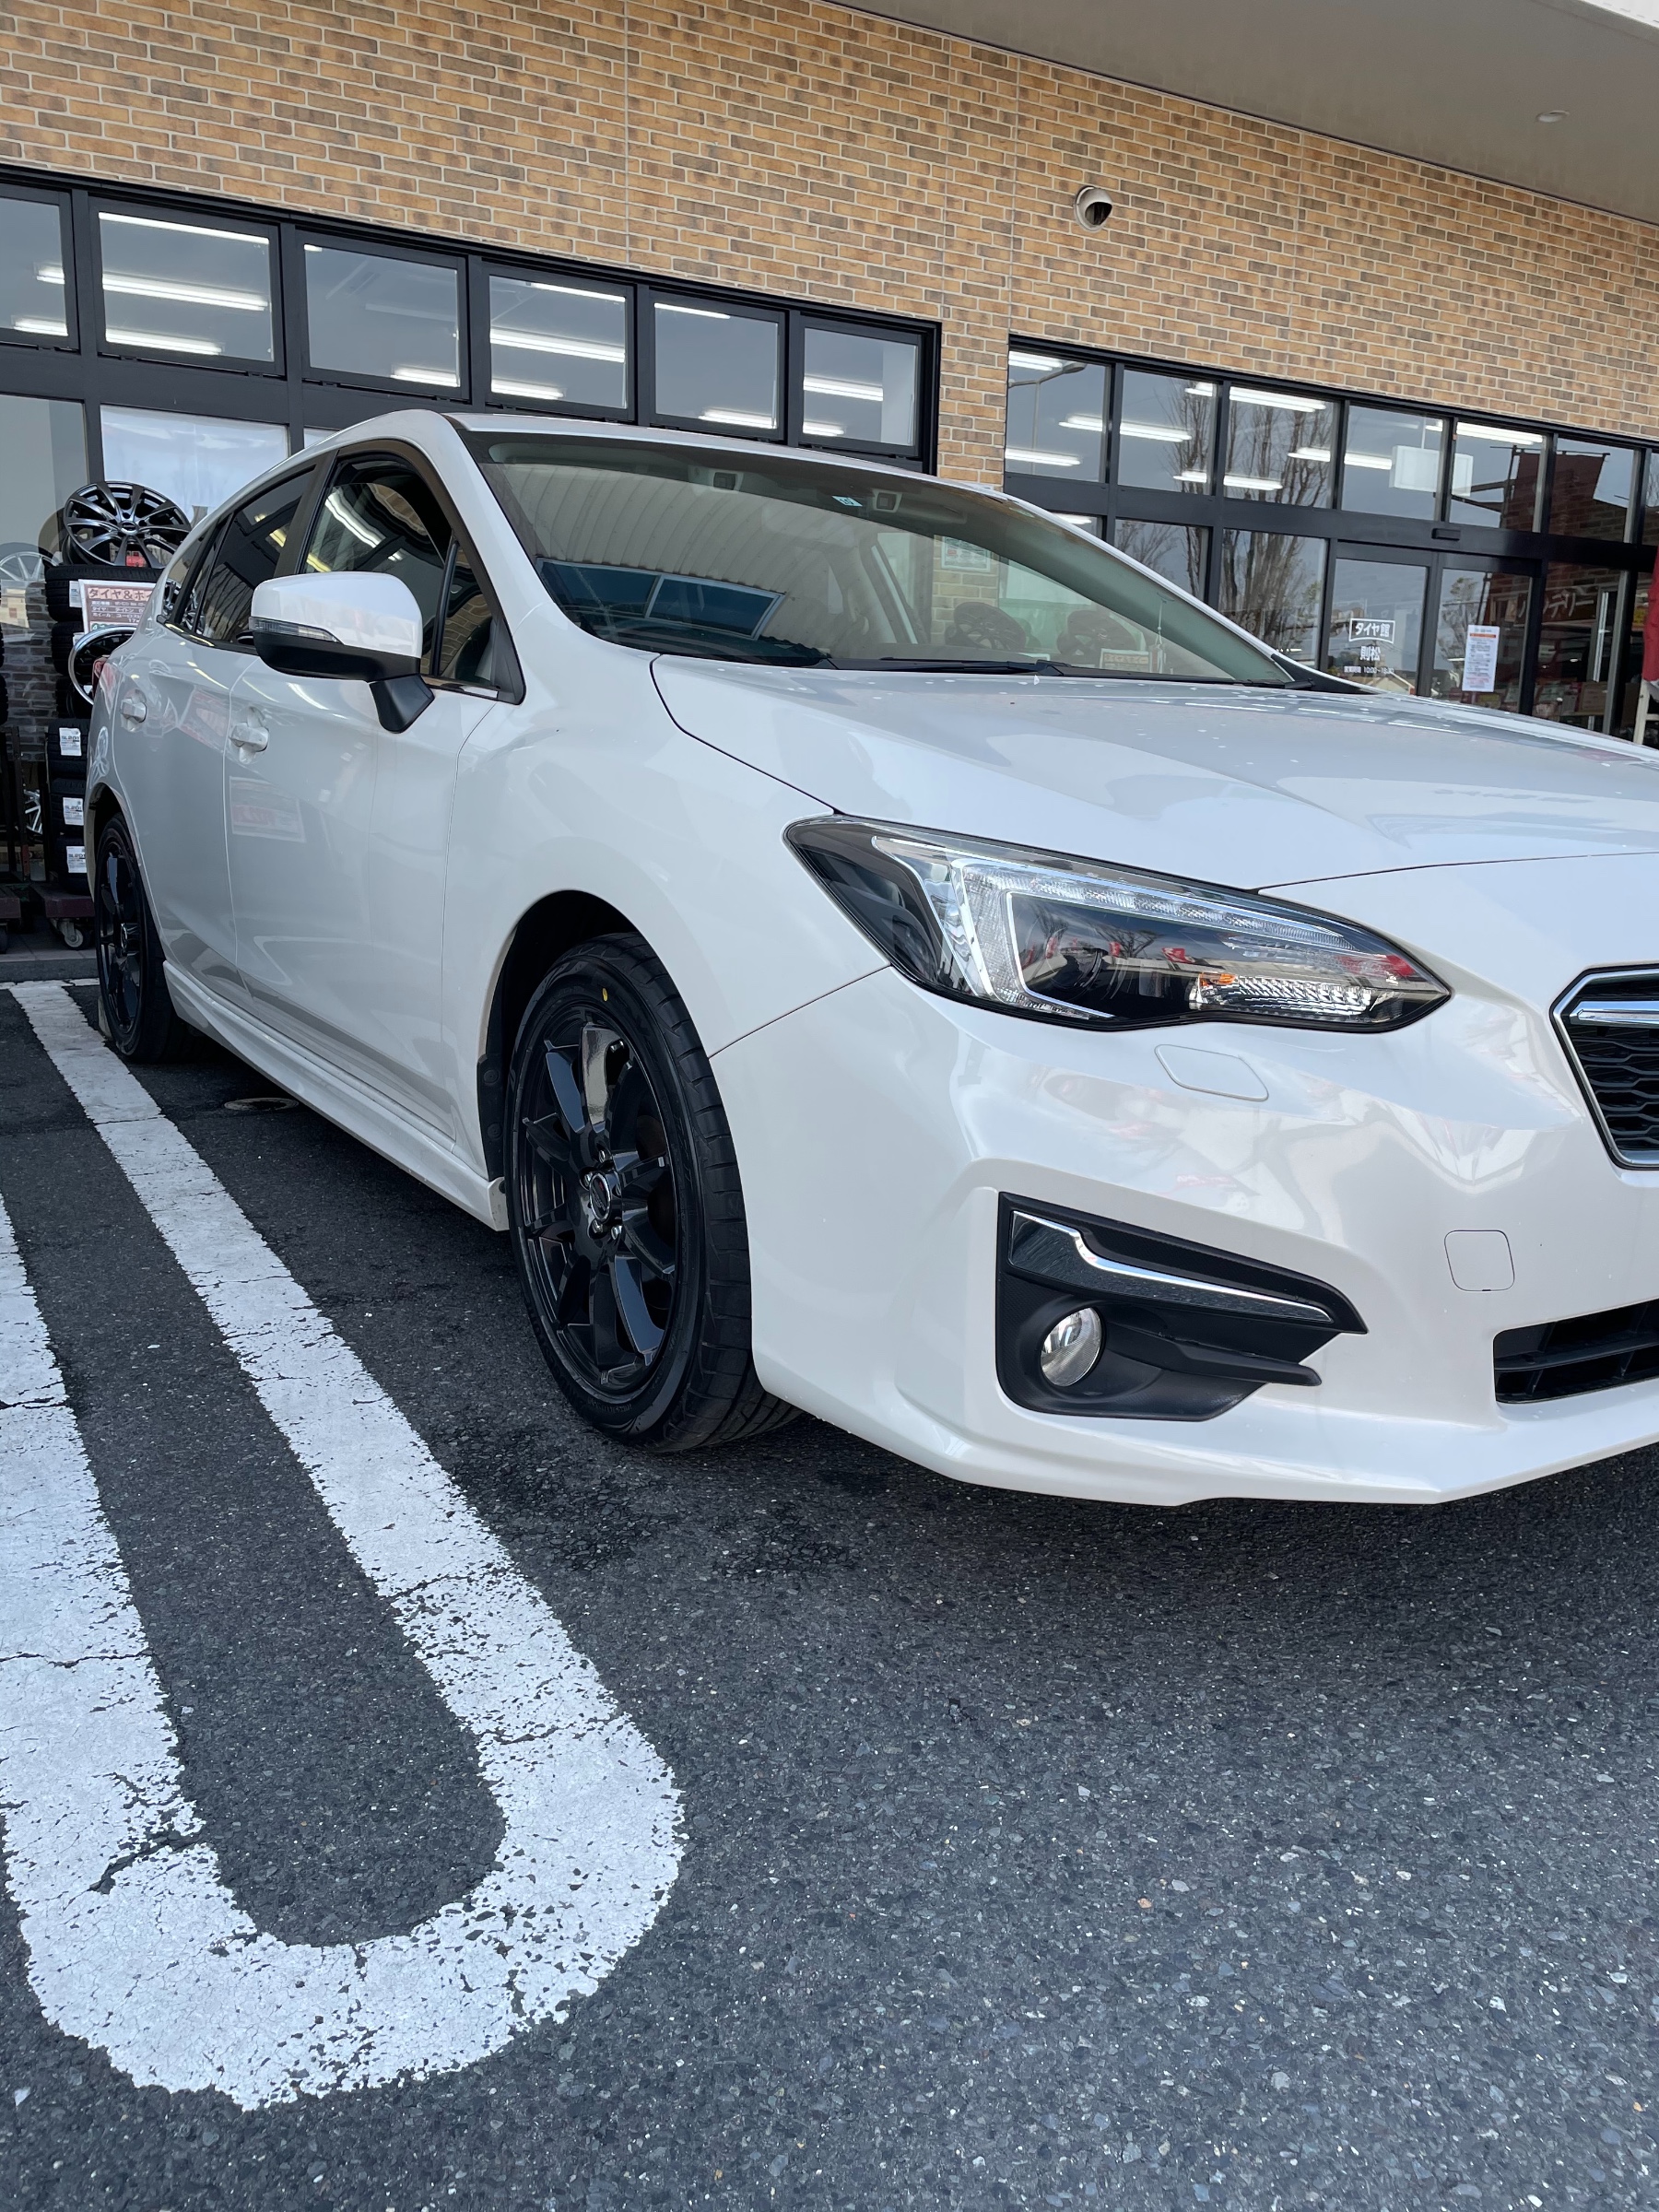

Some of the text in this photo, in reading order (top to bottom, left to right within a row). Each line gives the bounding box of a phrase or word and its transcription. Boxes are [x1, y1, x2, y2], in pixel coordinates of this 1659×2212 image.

[1355, 622, 1390, 637] タイヤ館
[1359, 645, 1381, 661] 則松
